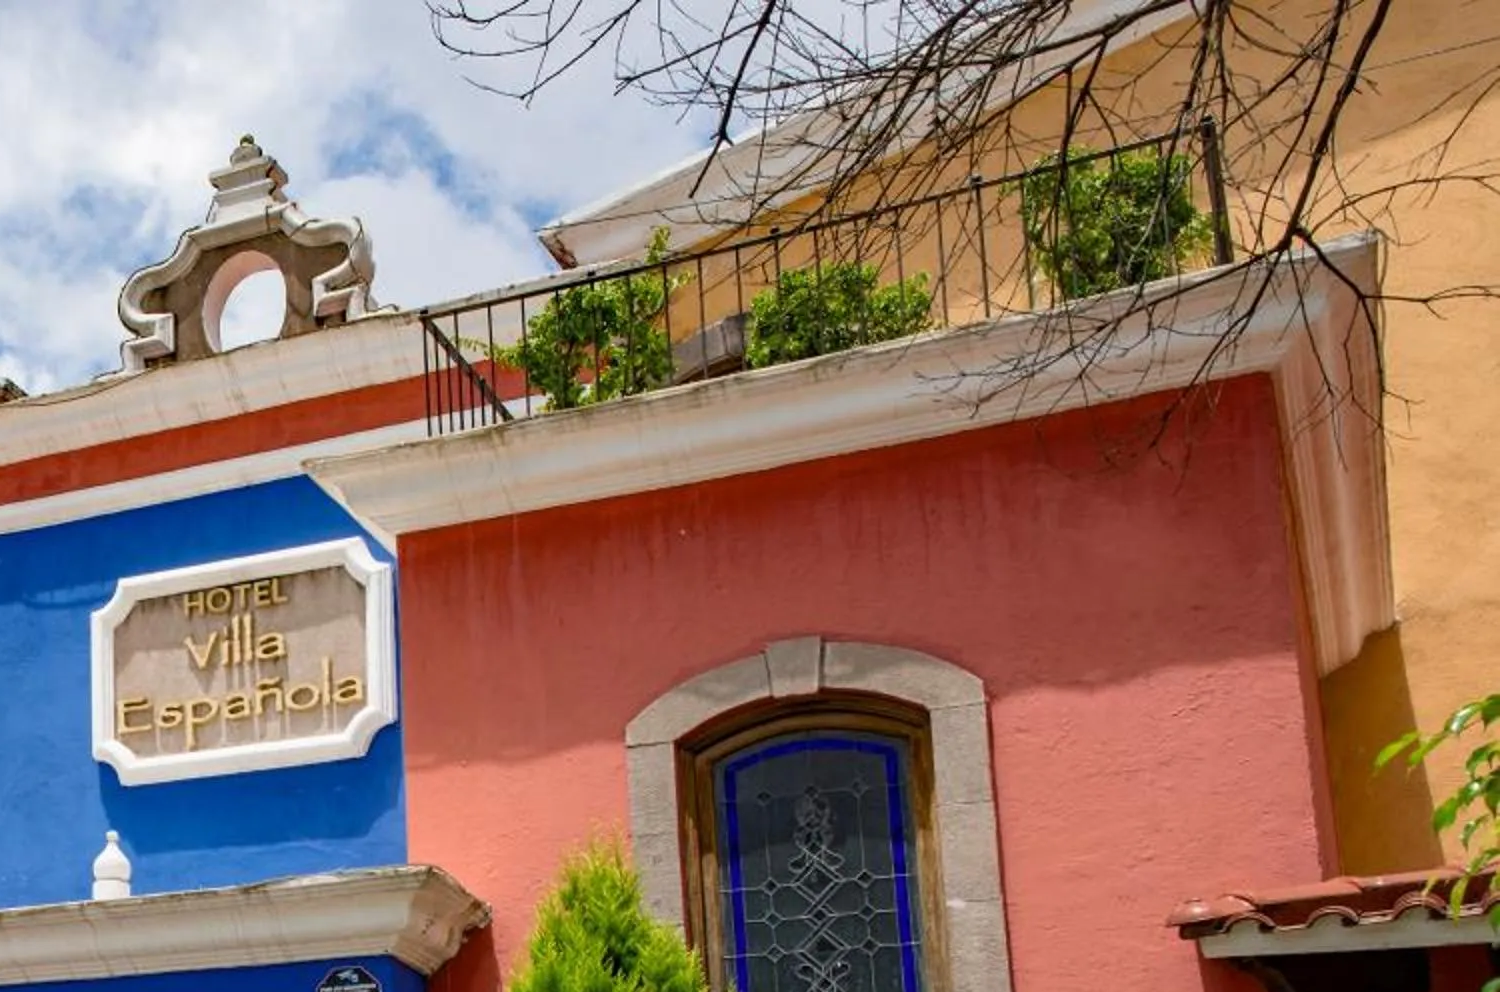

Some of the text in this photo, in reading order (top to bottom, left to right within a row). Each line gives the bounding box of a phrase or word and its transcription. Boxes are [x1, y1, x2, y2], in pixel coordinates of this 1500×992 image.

[183, 578, 288, 617] HOTEL
[184, 612, 287, 670] Villa
[116, 655, 365, 750] Española
